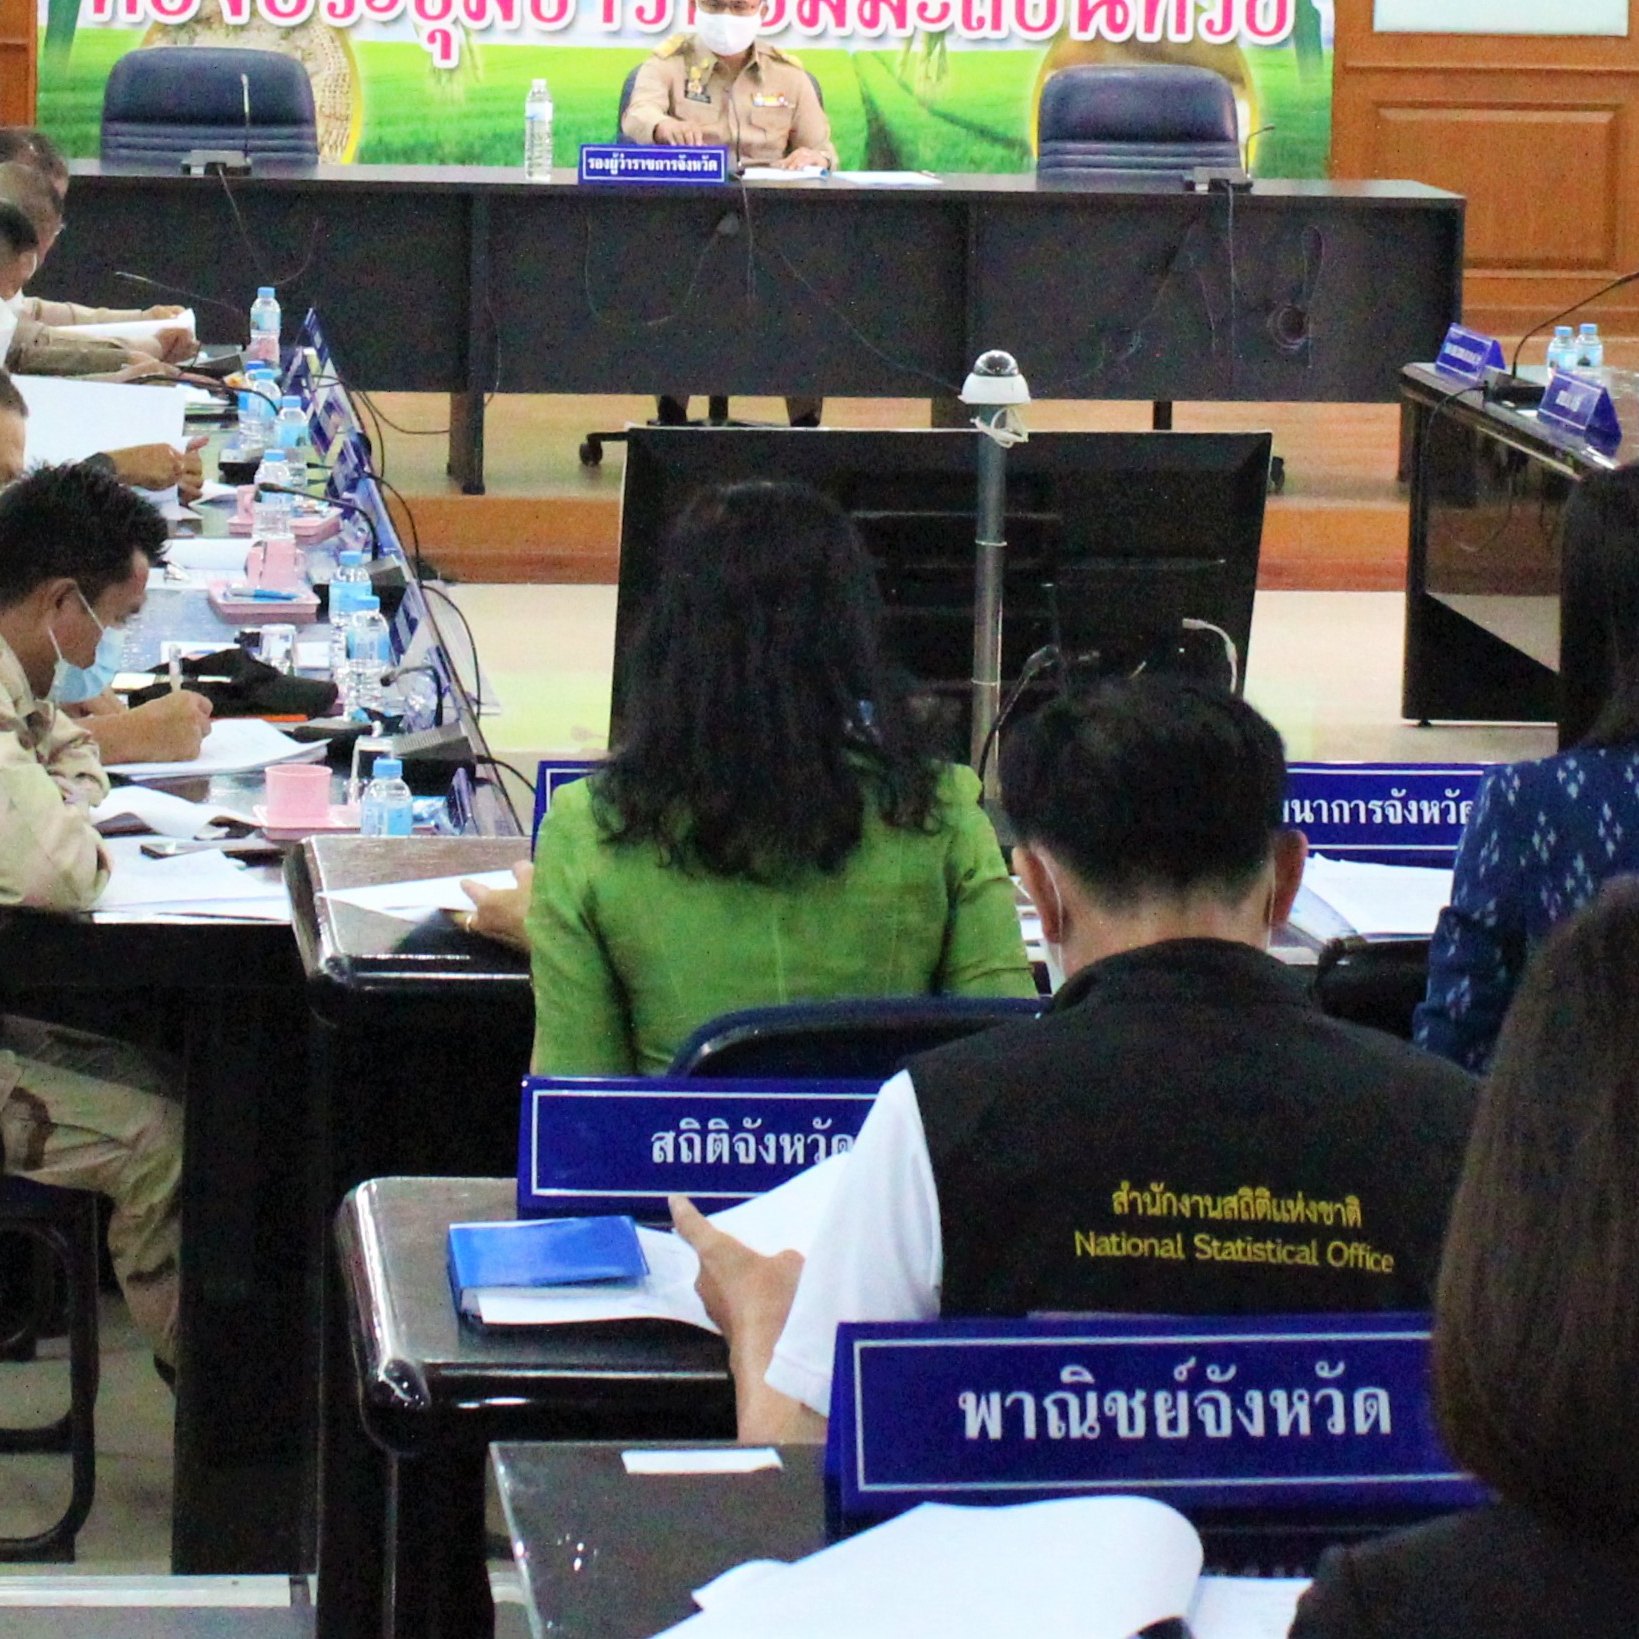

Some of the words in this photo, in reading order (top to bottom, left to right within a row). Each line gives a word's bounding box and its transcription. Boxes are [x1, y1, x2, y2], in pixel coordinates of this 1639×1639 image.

[1112, 1180, 1361, 1228] สำนักงานสถิติแห่งชาติ
[1074, 1230, 1185, 1260] National
[1193, 1232, 1319, 1266] Statistical
[1327, 1241, 1395, 1272] Office
[958, 1357, 1392, 1440] พาณิชย์จังหวัด
